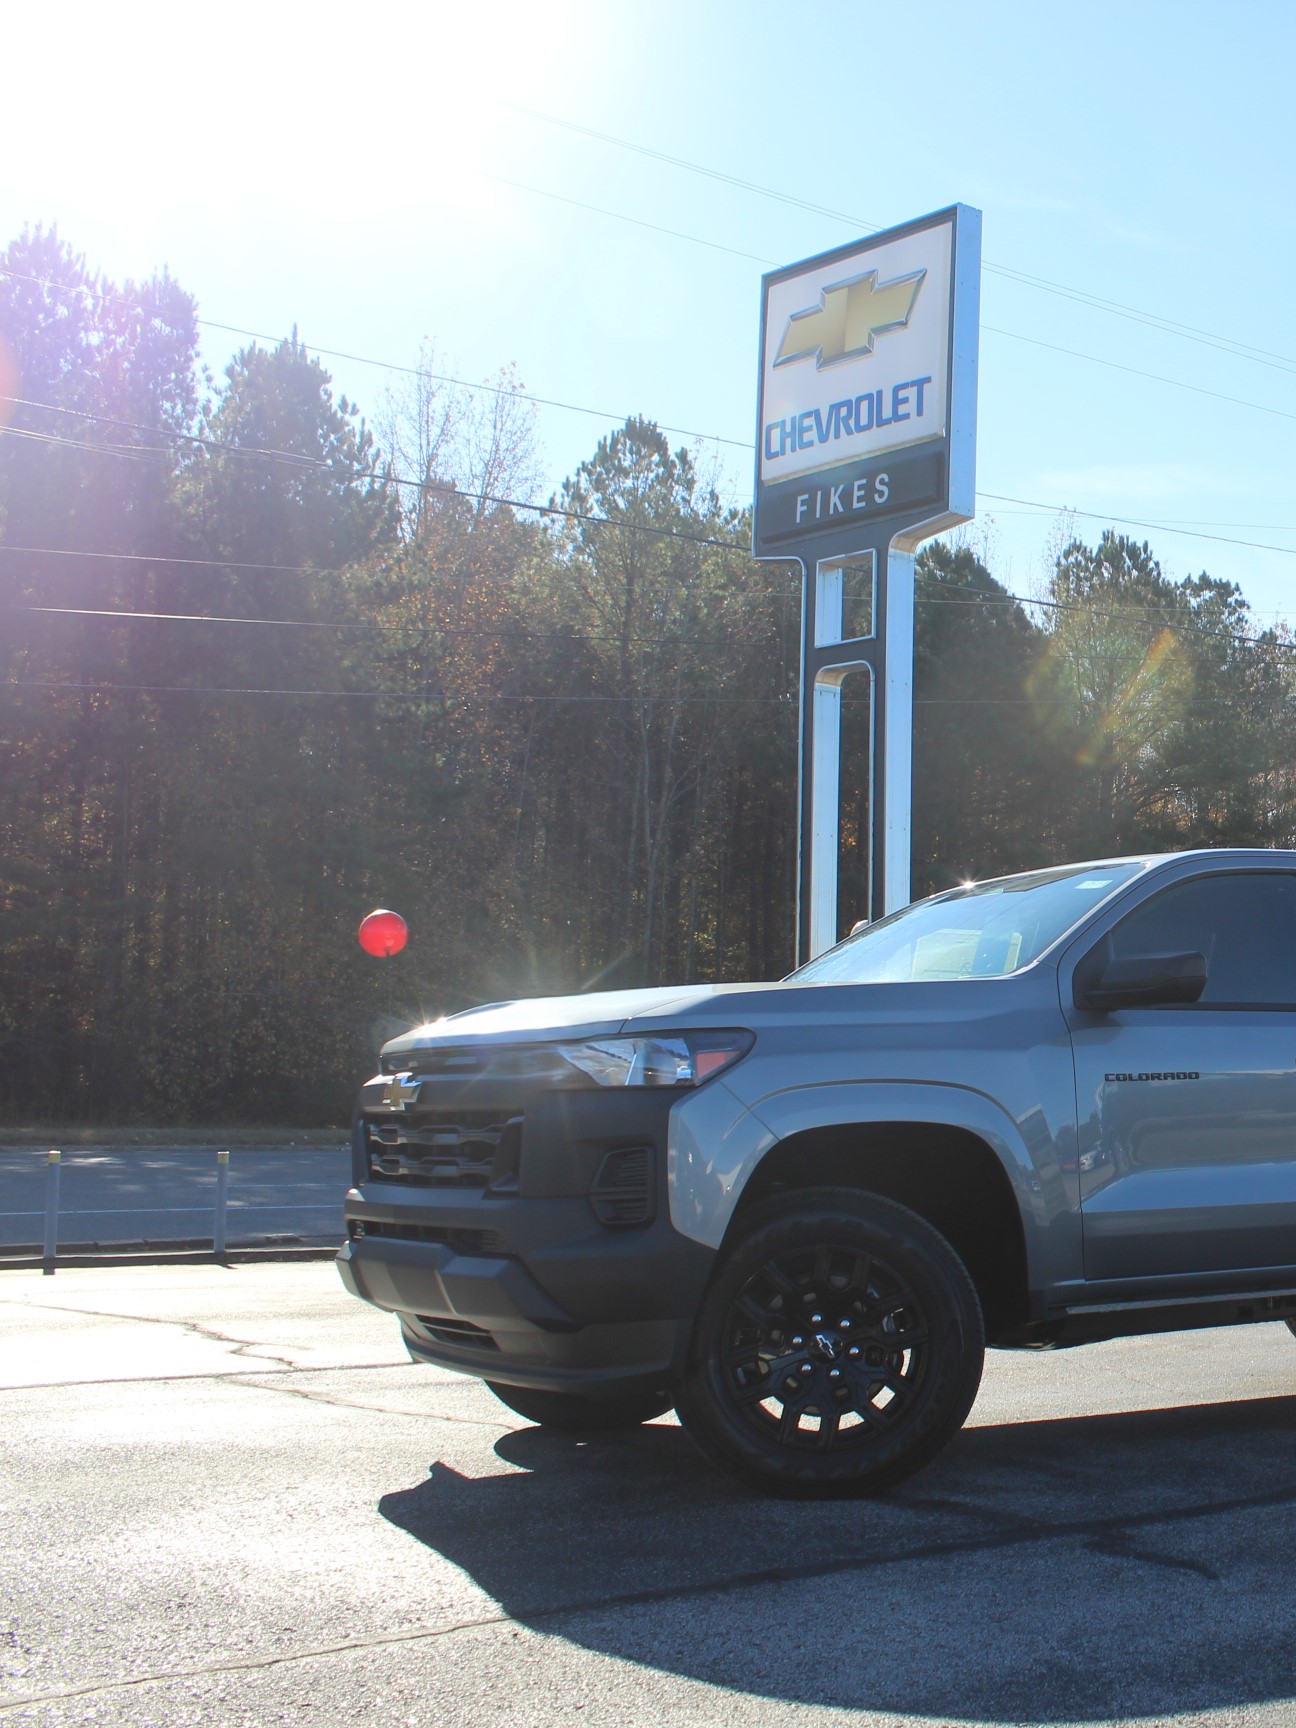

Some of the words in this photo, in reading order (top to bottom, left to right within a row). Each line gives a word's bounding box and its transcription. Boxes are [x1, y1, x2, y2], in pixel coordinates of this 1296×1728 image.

[765, 377, 932, 460] CHEVROLET
[796, 474, 889, 523] FIKES
[1105, 1072, 1200, 1082] COLORADO
